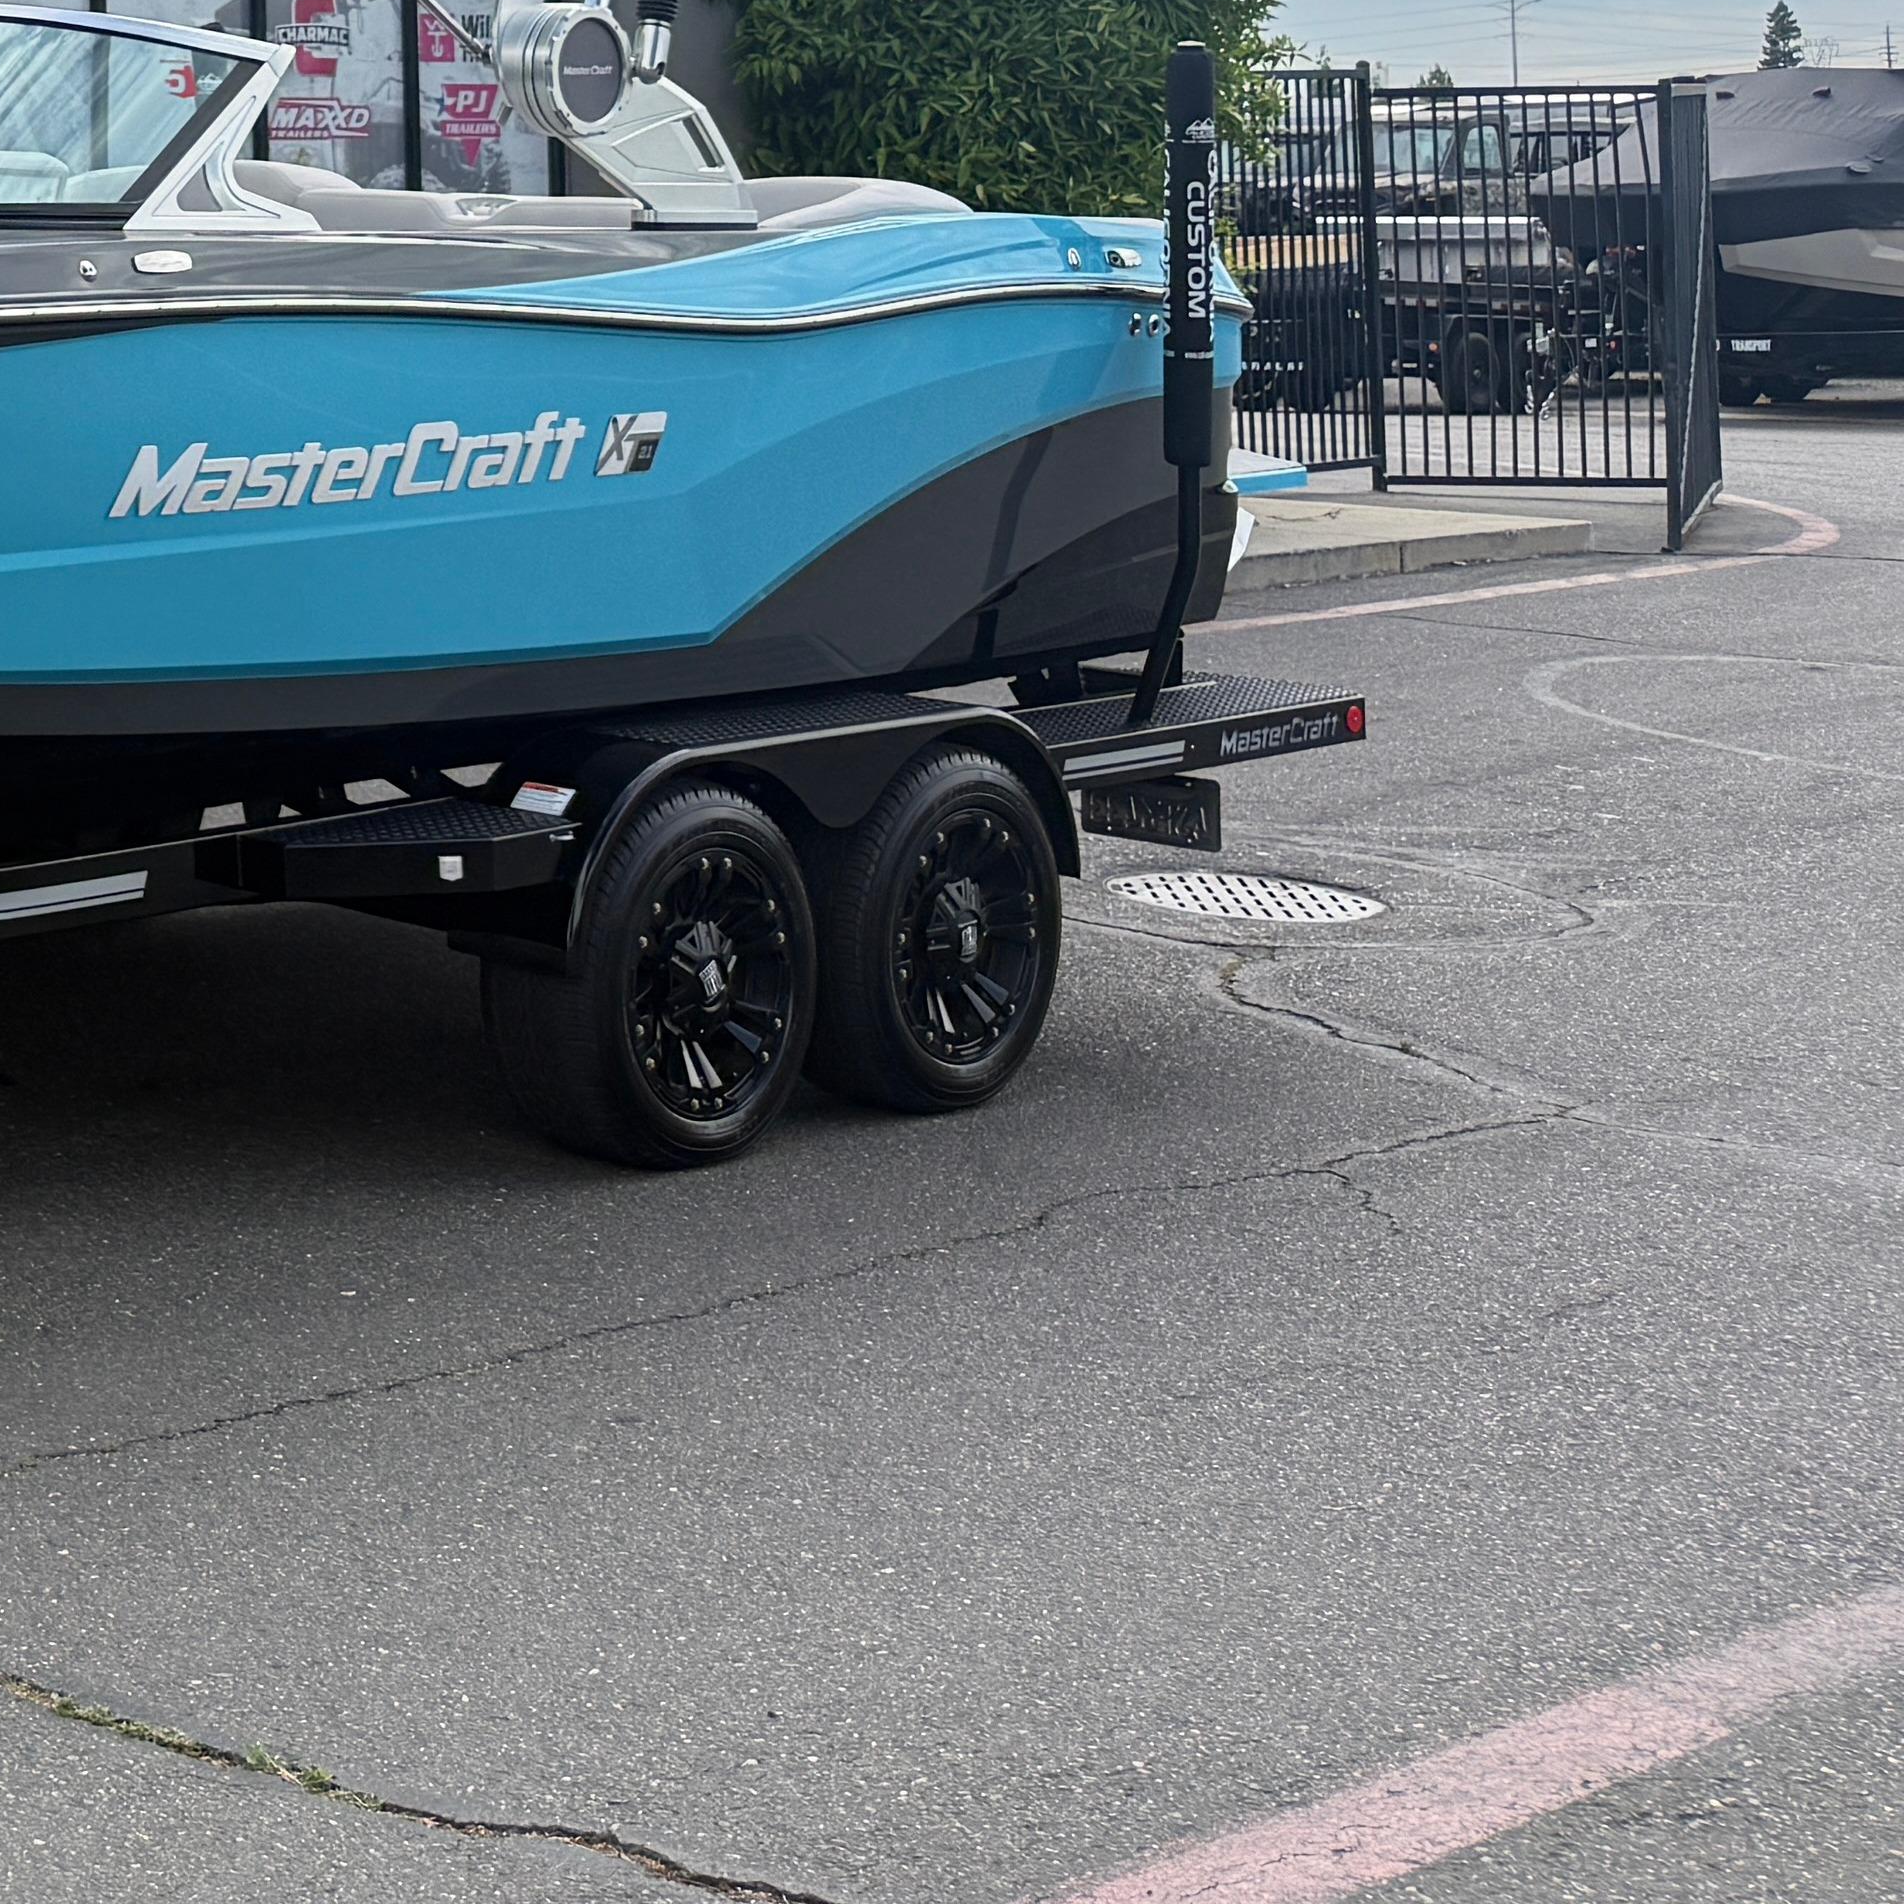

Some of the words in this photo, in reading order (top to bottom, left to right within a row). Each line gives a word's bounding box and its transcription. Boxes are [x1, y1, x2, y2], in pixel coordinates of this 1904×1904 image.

[276, 26, 350, 45] CHARMAC
[455, 90, 488, 113] PJ
[445, 122, 497, 135] TRAILERS
[1186, 181, 1207, 319] CUSTOM
[108, 409, 586, 518] MasterCraft
[1219, 712, 1341, 758] MasterCraft
